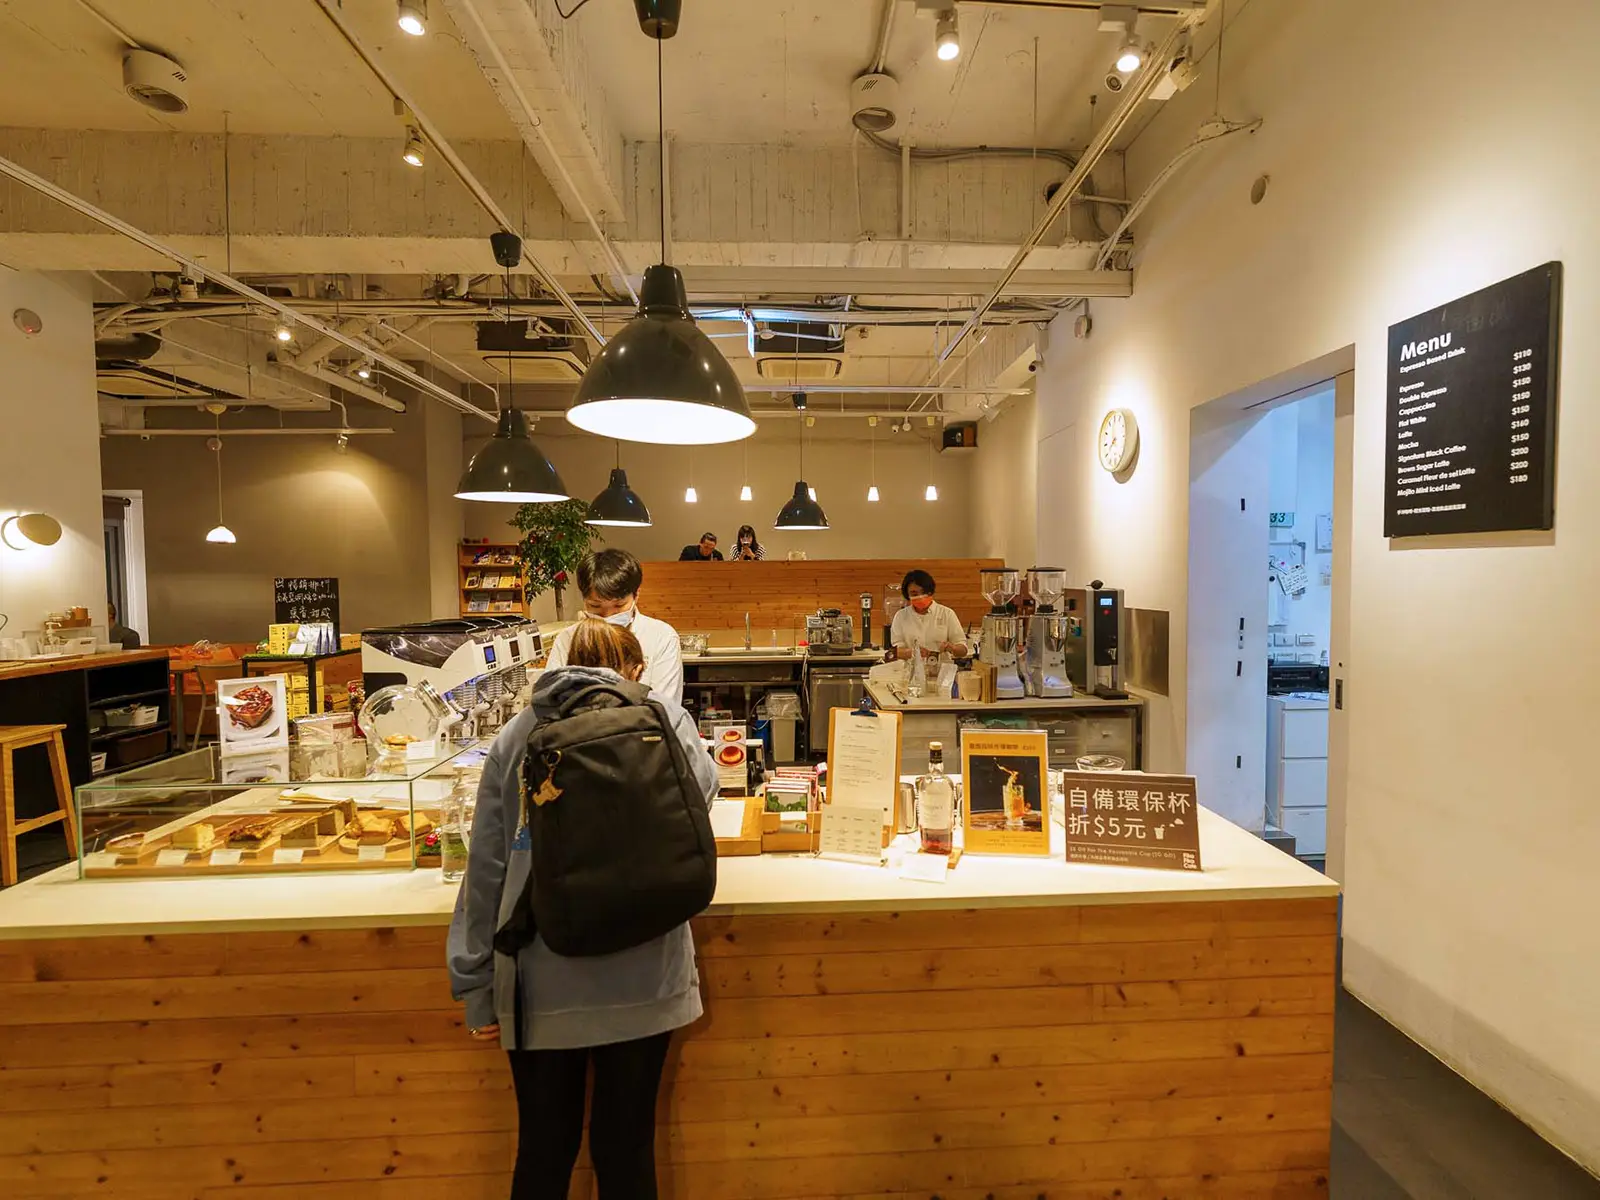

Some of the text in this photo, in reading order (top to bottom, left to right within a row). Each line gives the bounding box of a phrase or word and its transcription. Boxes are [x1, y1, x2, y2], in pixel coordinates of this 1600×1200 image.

[1400, 332, 1452, 361] Menu
[1399, 349, 1532, 393] Espresso $110
[1400, 347, 1466, 373] Espresso Based Drink
[1399, 362, 1532, 404] Double Espresso $130
[1399, 402, 1436, 415] Cappuccino
[1410, 416, 1426, 424] White
[1398, 405, 1530, 439] Latte $150
[1398, 442, 1419, 450] Mocha
[1398, 453, 1425, 462] Signature
[1426, 449, 1444, 457] Black
[1444, 445, 1466, 454] Coffee
[1511, 446, 1529, 457] $200
[1397, 476, 1422, 484] Caramel
[1459, 468, 1476, 476] Latte
[1510, 460, 1529, 470] $200
[1069, 787, 1190, 814] 自備環保杯
[1069, 813, 1146, 840] 折$5元
